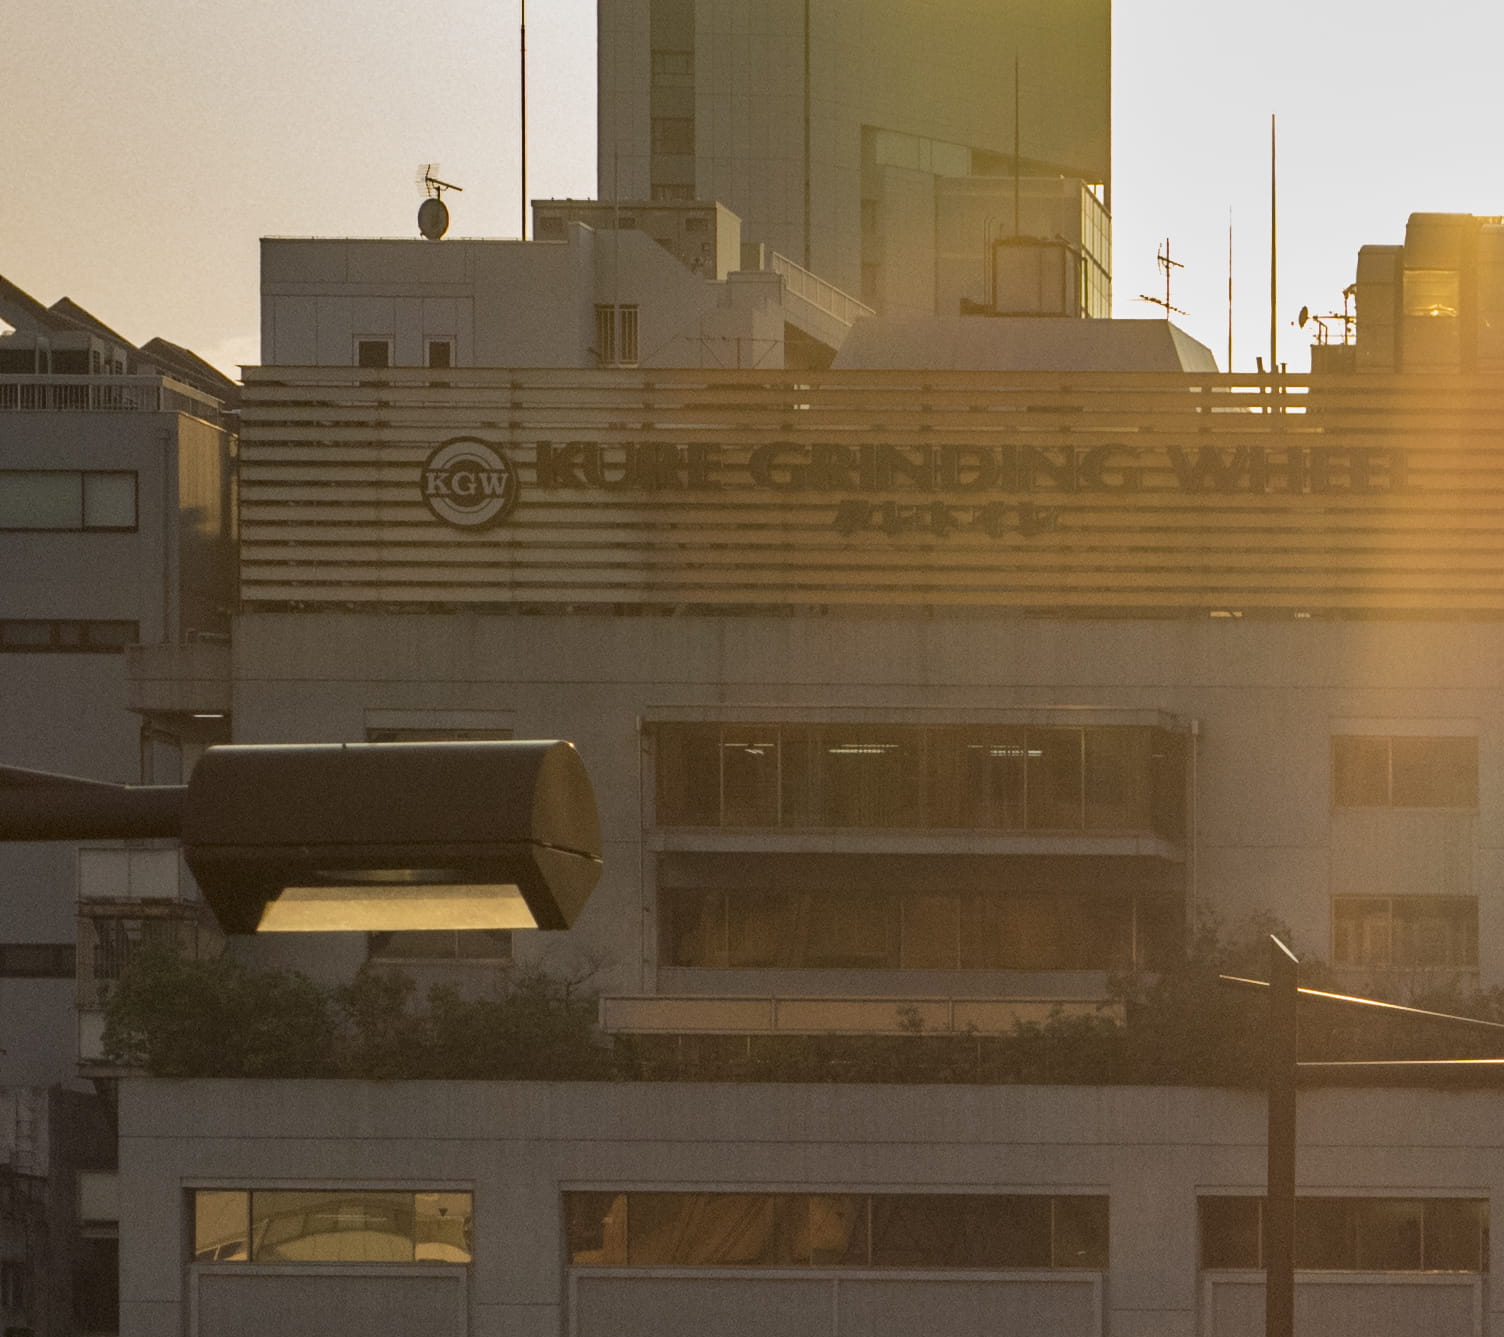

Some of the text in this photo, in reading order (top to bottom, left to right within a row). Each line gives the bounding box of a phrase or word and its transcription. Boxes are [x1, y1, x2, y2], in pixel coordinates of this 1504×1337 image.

[424, 471, 510, 497] KGW
[536, 440, 722, 491] KURE
[750, 441, 1140, 493] GRINDING
